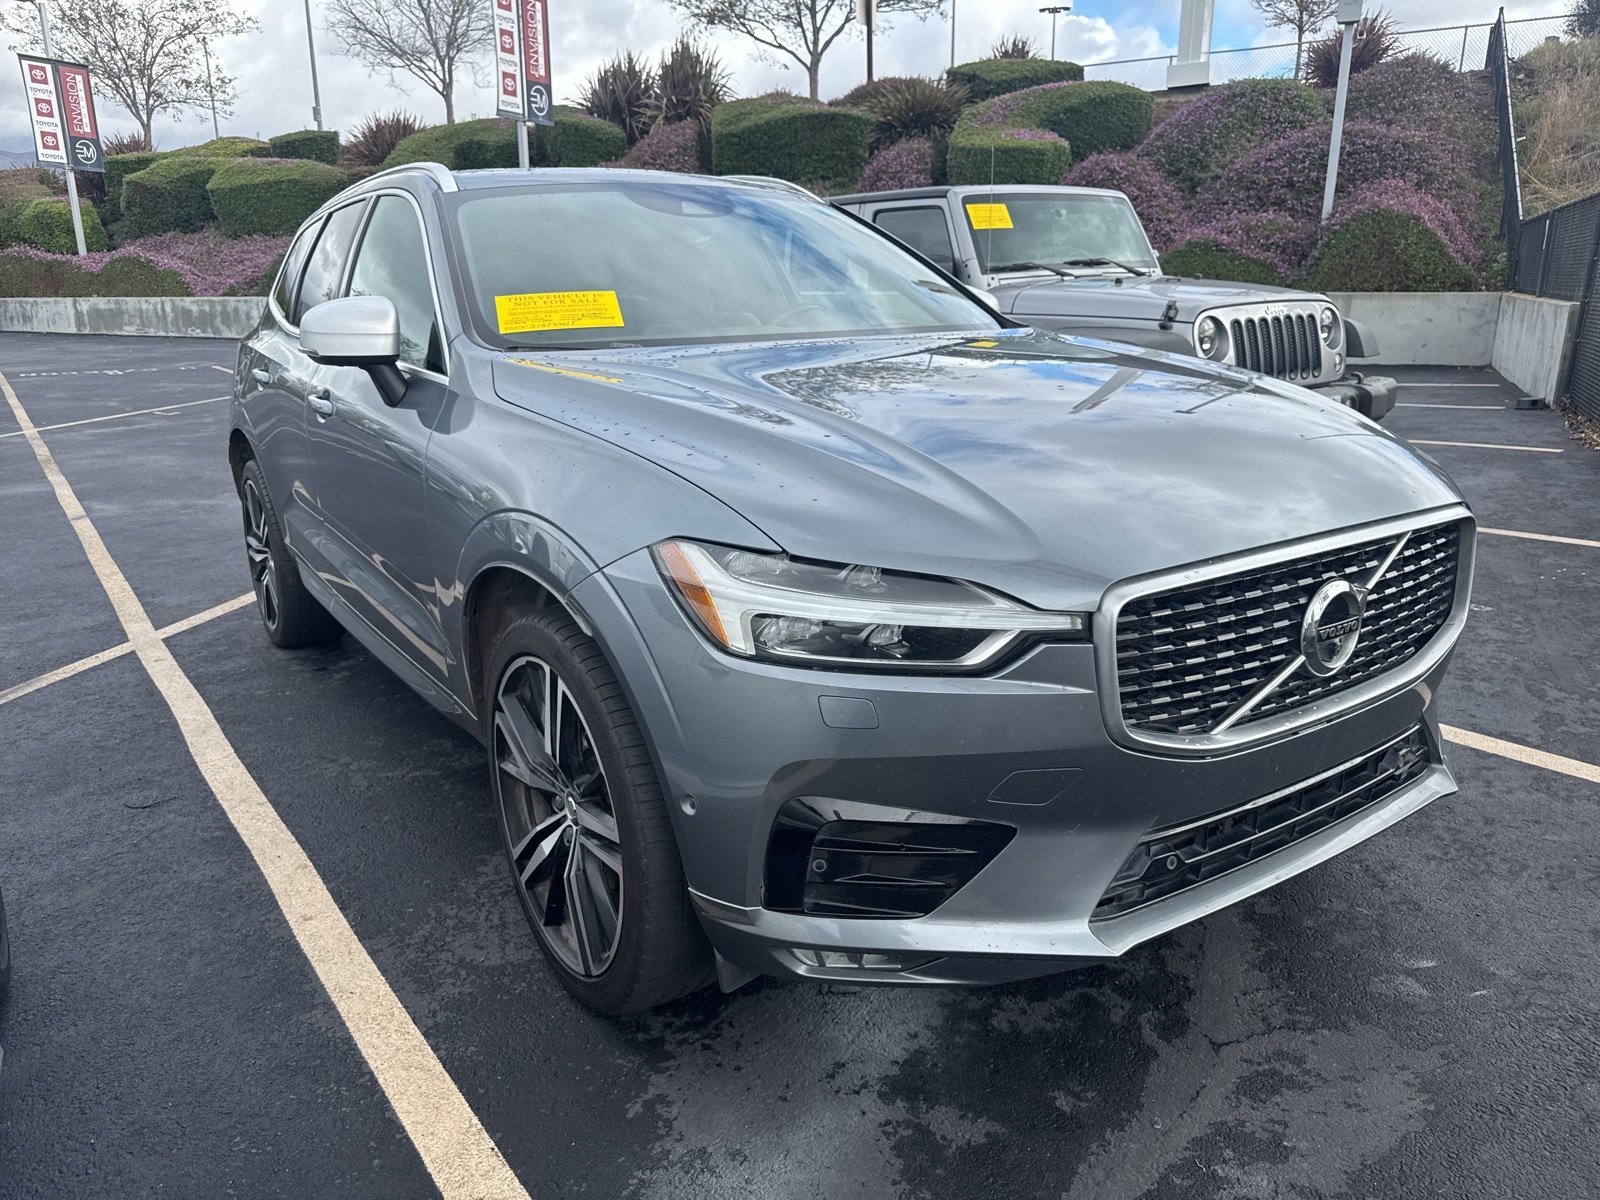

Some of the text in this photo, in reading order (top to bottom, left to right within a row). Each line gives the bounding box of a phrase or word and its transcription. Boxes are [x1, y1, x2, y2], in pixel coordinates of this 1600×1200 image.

[29, 86, 53, 96] TOYOTA
[65, 72, 84, 134] ENVISION
[35, 120, 59, 129] TOYOTA
[41, 153, 65, 161] TOYOTA
[1319, 620, 1358, 640] VOLVO
